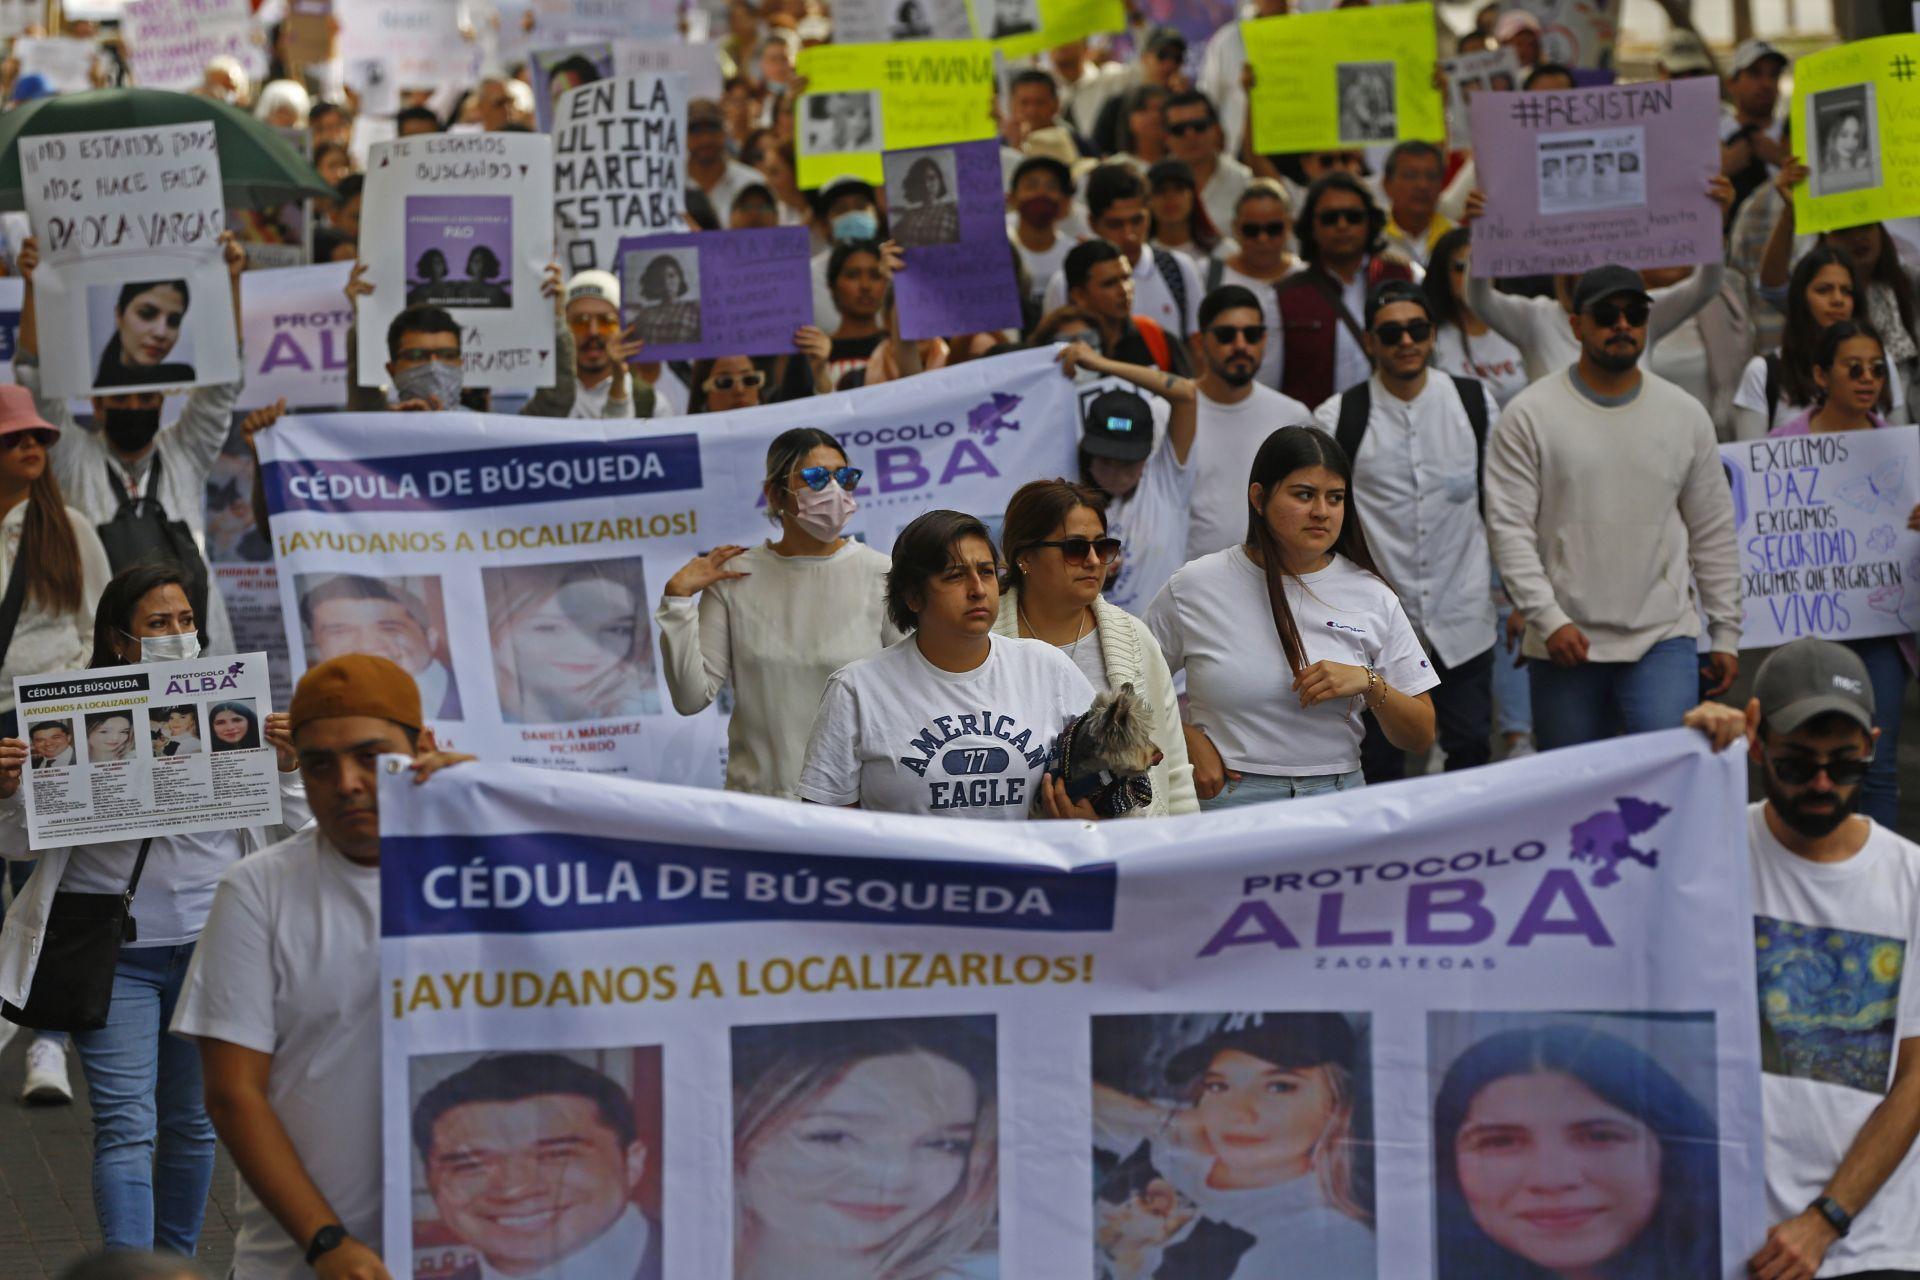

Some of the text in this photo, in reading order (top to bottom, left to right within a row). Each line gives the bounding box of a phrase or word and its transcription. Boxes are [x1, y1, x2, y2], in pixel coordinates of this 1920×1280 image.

[570, 78, 670, 119] EN LA
[1510, 82, 1673, 128] #RESISTAN
[80, 133, 164, 160] ESTAMOS
[425, 136, 506, 155] ESTAMOS
[556, 116, 680, 155] ULTIMA
[96, 172, 148, 198] HACE
[160, 165, 209, 192] FALTA
[415, 159, 512, 182] BUSCANDO
[554, 153, 679, 192] MARCHA
[554, 192, 684, 229] ESTABA
[48, 213, 131, 250] PAOLA
[1750, 435, 1849, 473] EXIGIMOS
[288, 452, 666, 501] CÉDULA DE BÚSQUEDA
[1764, 467, 1825, 507] PAZ
[454, 534, 476, 553] A
[482, 510, 698, 552] LOCALIZARLOS!
[1755, 505, 1838, 535] EXIGIMOS
[1746, 528, 1857, 573] SEGURIDAD
[1805, 568, 1829, 592] QUE
[1768, 591, 1852, 637] VIVOS
[27, 679, 139, 698] CÉDULA DE BÚSQUEDA
[165, 675, 237, 696] ALBA
[170, 670, 225, 680] PROTOCOLO
[85, 695, 149, 710] LOCALIZARLOS!
[521, 727, 575, 741] DANIELA
[899, 710, 1050, 778] AMERICAN
[963, 749, 990, 774] 77
[929, 777, 1026, 810] EAGLE
[422, 857, 1053, 916] CÉDULA DE BÚSQUEDA
[1242, 840, 1547, 896] PROTOCOLO
[1196, 868, 1615, 958] ALBA
[1314, 955, 1497, 970] ZACATECAS
[392, 952, 1095, 1019] ¡AYUDANOS A LOCALIZARLOS!
